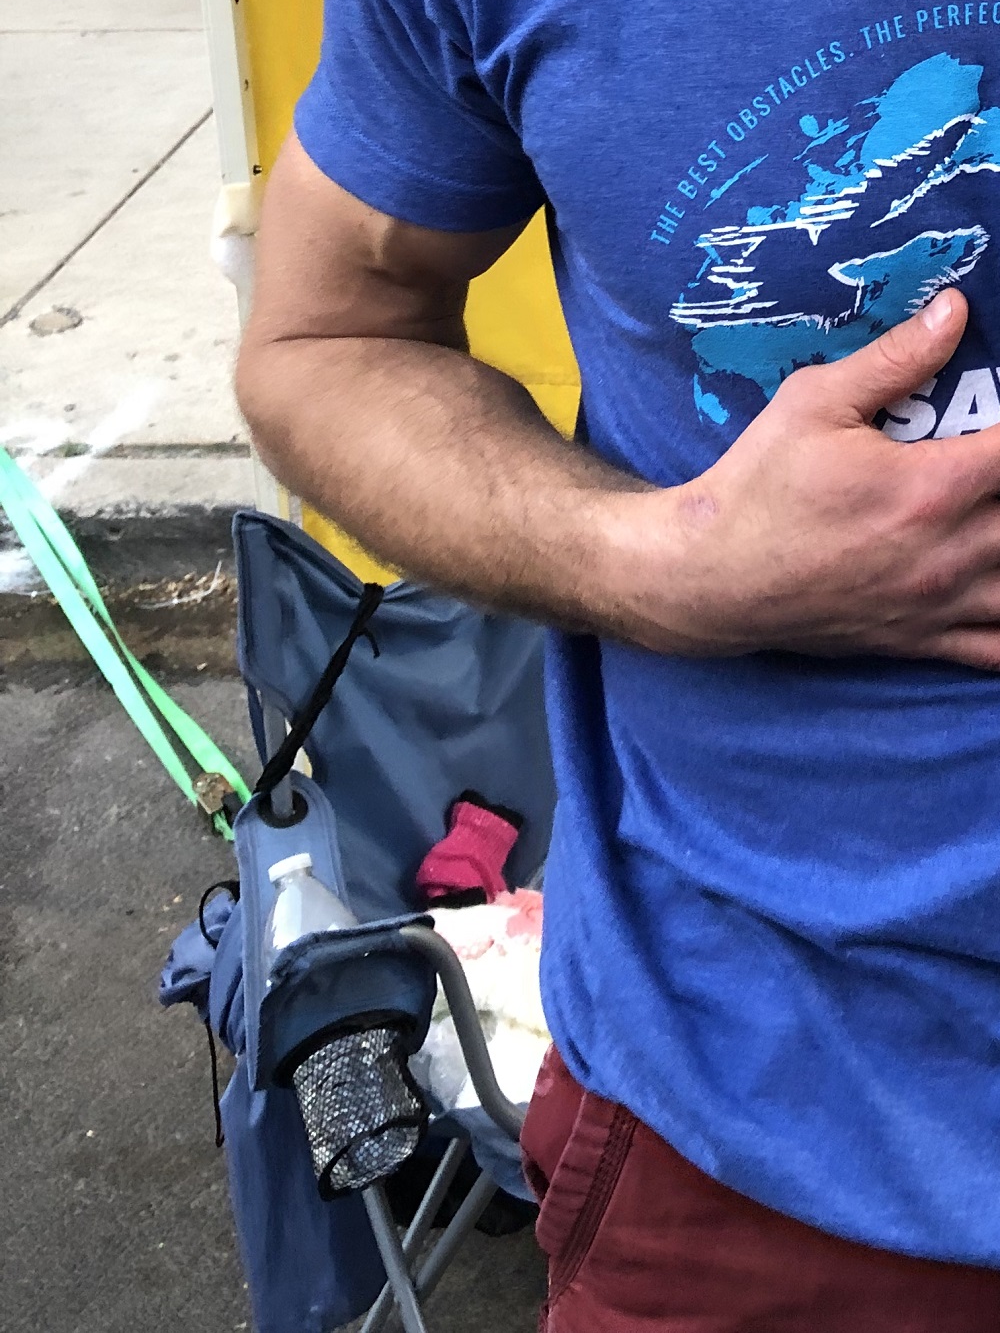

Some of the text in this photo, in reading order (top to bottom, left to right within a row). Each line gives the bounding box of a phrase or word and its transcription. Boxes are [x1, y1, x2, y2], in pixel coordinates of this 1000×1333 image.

[650, 201, 686, 245] THE
[677, 139, 726, 200] BEST
[726, 40, 855, 142] OBSTACLES.
[859, 14, 907, 50] THE
